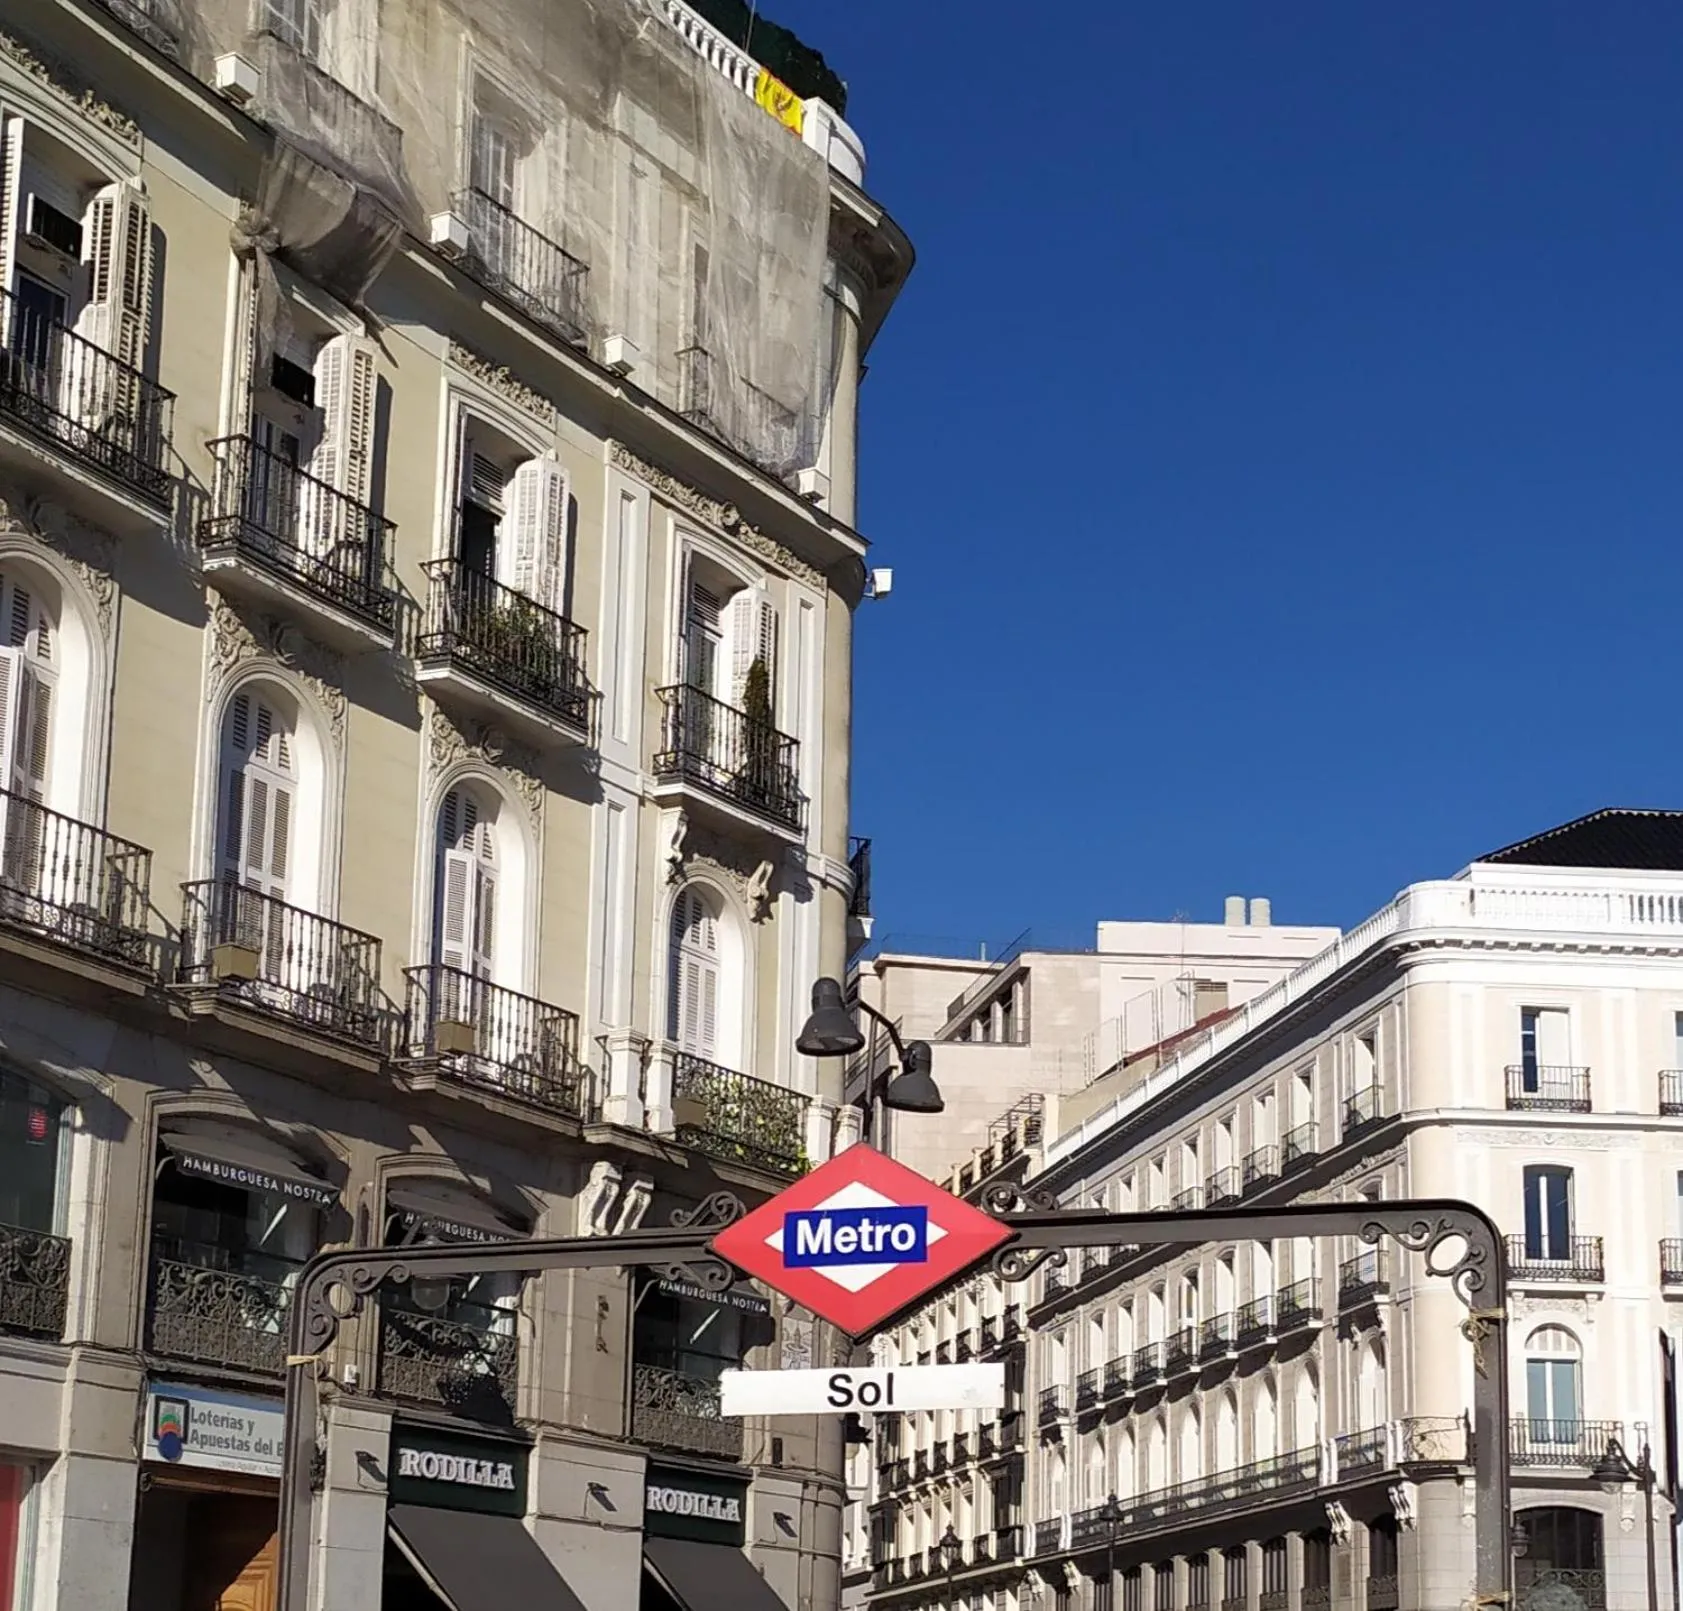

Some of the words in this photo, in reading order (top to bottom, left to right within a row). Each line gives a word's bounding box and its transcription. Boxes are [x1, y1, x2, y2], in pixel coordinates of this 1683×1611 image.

[183, 1155, 279, 1191] HAMBURGUESA
[283, 1182, 332, 1205] NOSTRA
[405, 1212, 485, 1241] HURGUESA
[796, 1217, 917, 1256] Metro
[660, 1280, 728, 1304] HAMBURGUESA
[732, 1296, 768, 1313] NOSTRA
[826, 1372, 894, 1408] Sol
[189, 1428, 251, 1452] Apuestas
[254, 1438, 273, 1456] del
[247, 1419, 255, 1436] y
[398, 1447, 516, 1490] RODILLA
[645, 1485, 741, 1523] RODILLA
